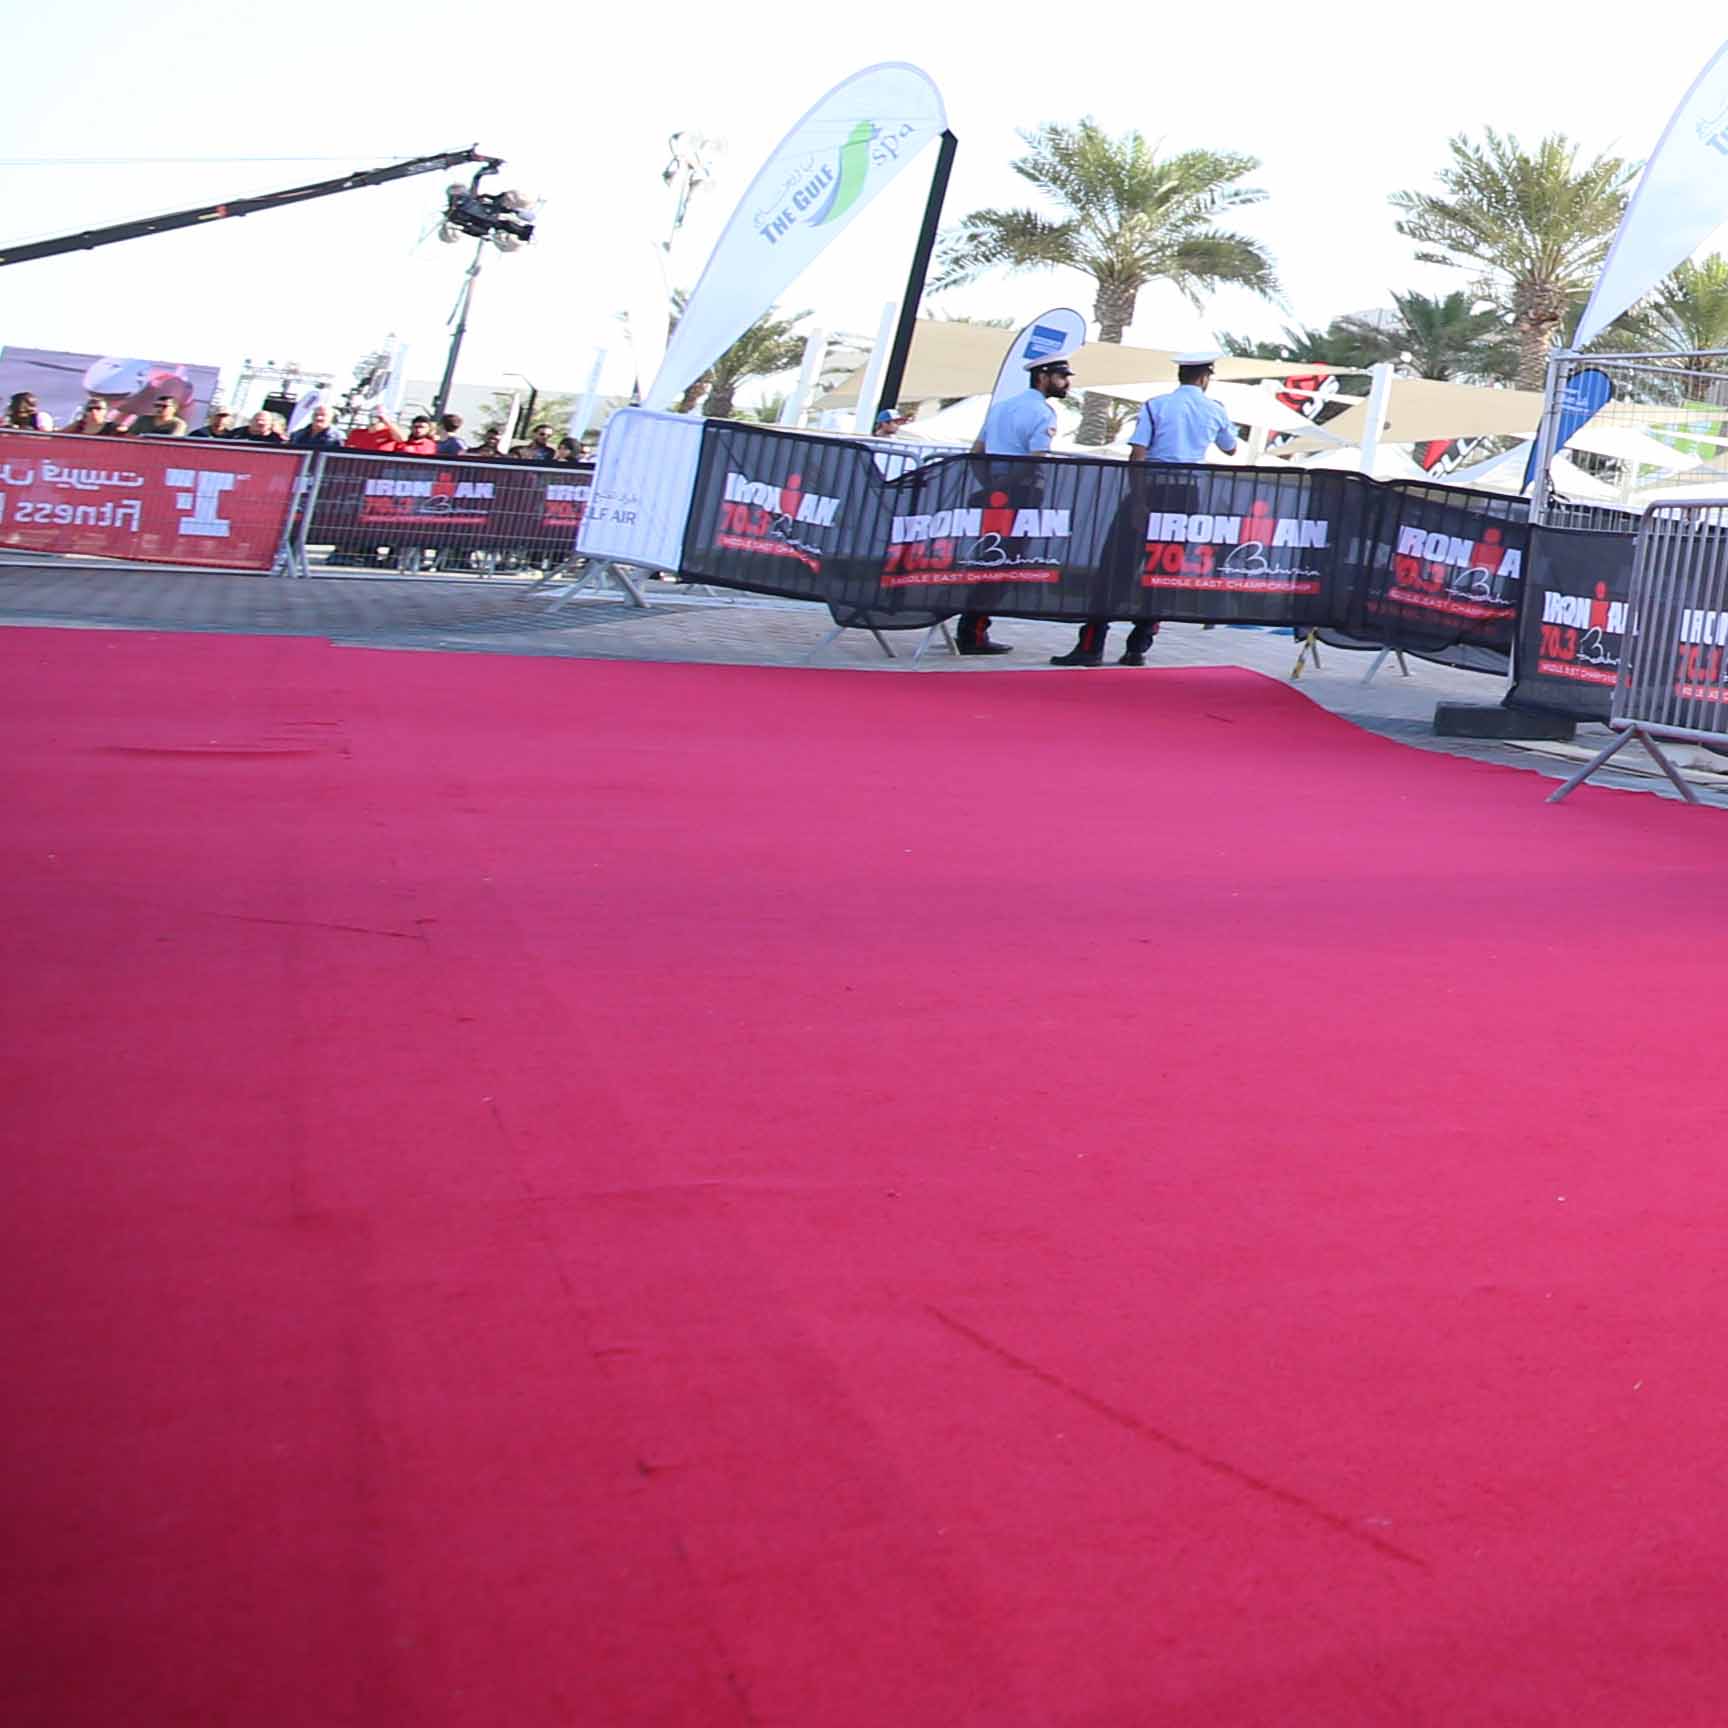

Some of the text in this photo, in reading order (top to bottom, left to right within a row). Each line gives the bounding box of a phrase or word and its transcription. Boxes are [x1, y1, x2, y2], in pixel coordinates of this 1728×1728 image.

[760, 208, 796, 244] THE
[793, 164, 834, 211] GULF
[724, 472, 841, 527] IRONMAN
[891, 491, 1072, 544] IRONMAN
[1146, 500, 1329, 549] IRONMAN
[1144, 543, 1215, 573] 70.3
